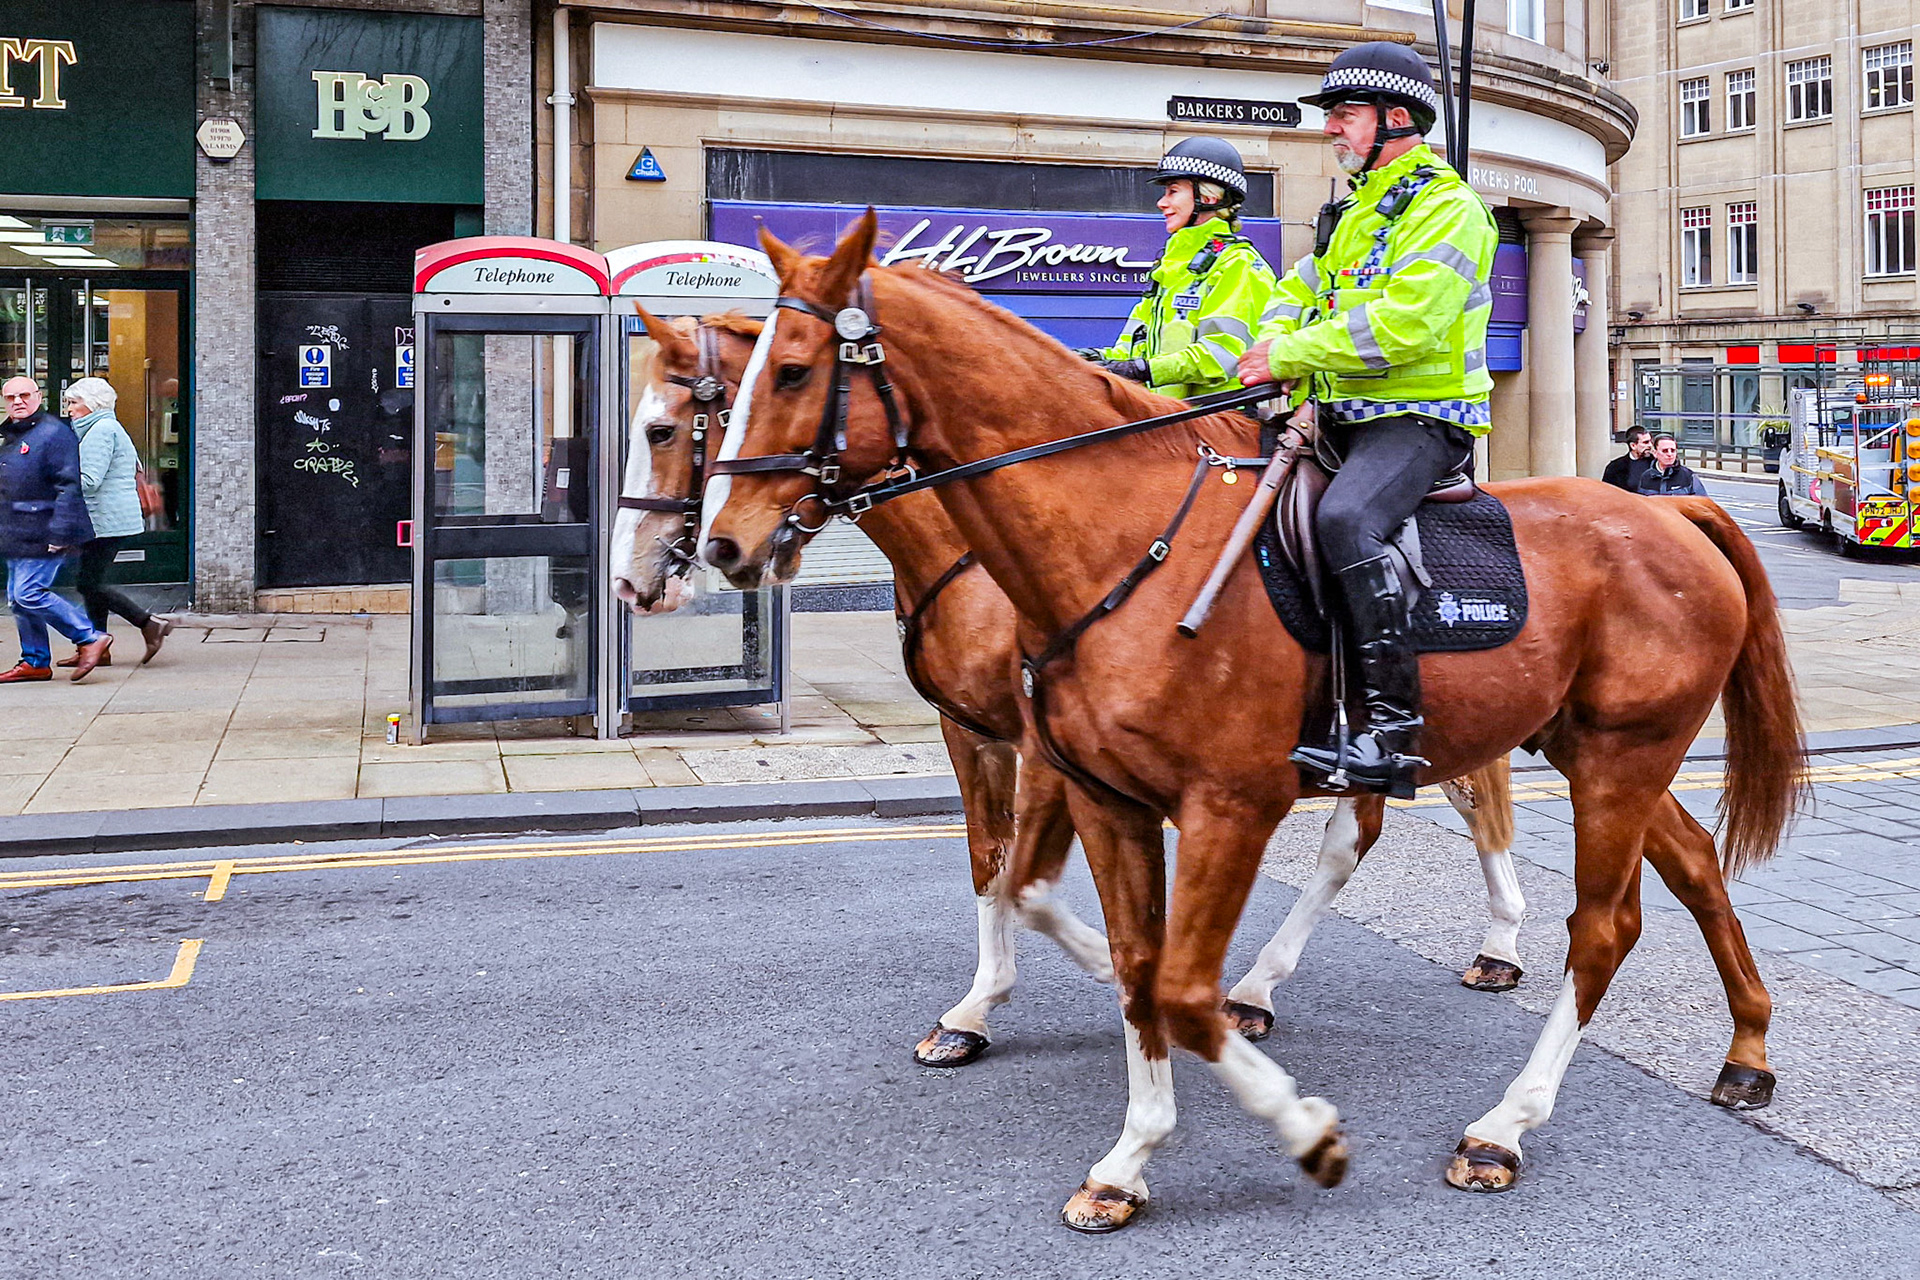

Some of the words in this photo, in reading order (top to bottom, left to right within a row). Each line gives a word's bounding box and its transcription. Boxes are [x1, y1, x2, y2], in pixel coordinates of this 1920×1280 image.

[1177, 102, 1244, 119] BARKER'S
[1251, 106, 1288, 122] POOL
[635, 168, 660, 176] Chubb
[1467, 167, 1509, 190] ARKERS
[963, 227, 1154, 284] Brown
[474, 267, 555, 286] Telephone
[666, 271, 742, 289] Telephone
[1016, 271, 1085, 283] JEWELLERS
[1090, 271, 1128, 283] SINCE
[17, 305, 45, 314] SE
[1174, 296, 1199, 306] POLICE
[1461, 604, 1509, 621] POLICE
